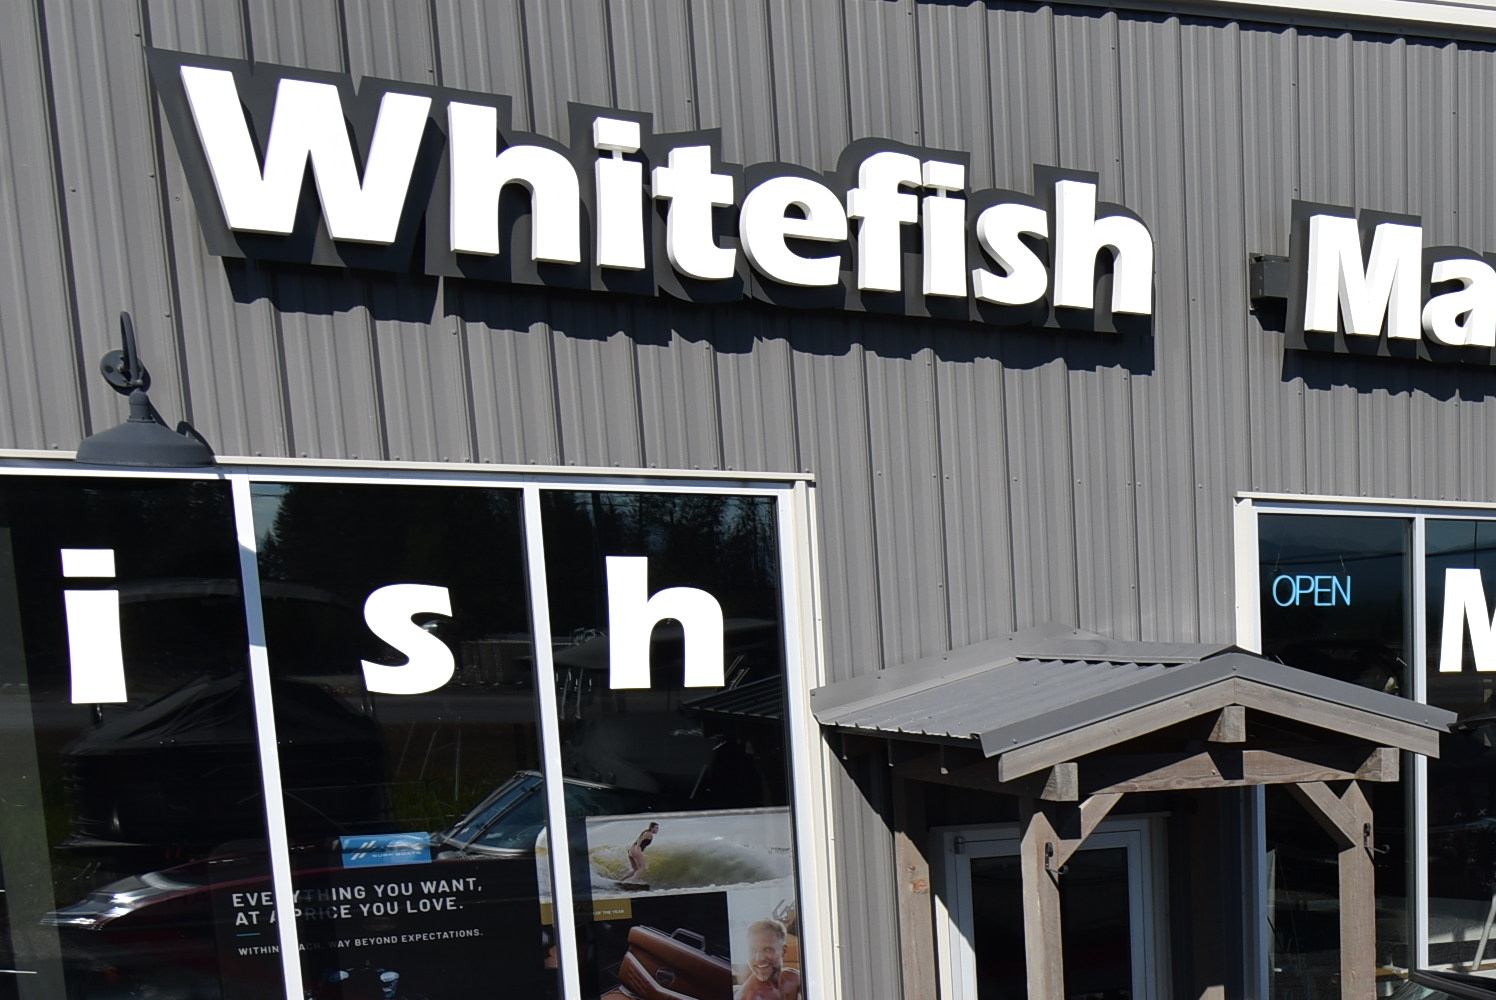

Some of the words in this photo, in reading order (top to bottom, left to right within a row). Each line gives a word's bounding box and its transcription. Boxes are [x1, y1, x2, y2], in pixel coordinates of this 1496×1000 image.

[179, 65, 1154, 315] Whitefish
[1272, 574, 1352, 608] OPEN
[232, 885, 366, 907] EVEYTHING
[373, 881, 413, 898] YOU
[420, 877, 482, 895] WANT,
[235, 911, 260, 926] AT
[359, 901, 399, 916] YOU
[407, 897, 464, 914] LOVE.
[238, 945, 279, 956] WITHIN
[355, 935, 398, 947] BEYOND
[401, 928, 483, 943] EXPECTATIONS.
